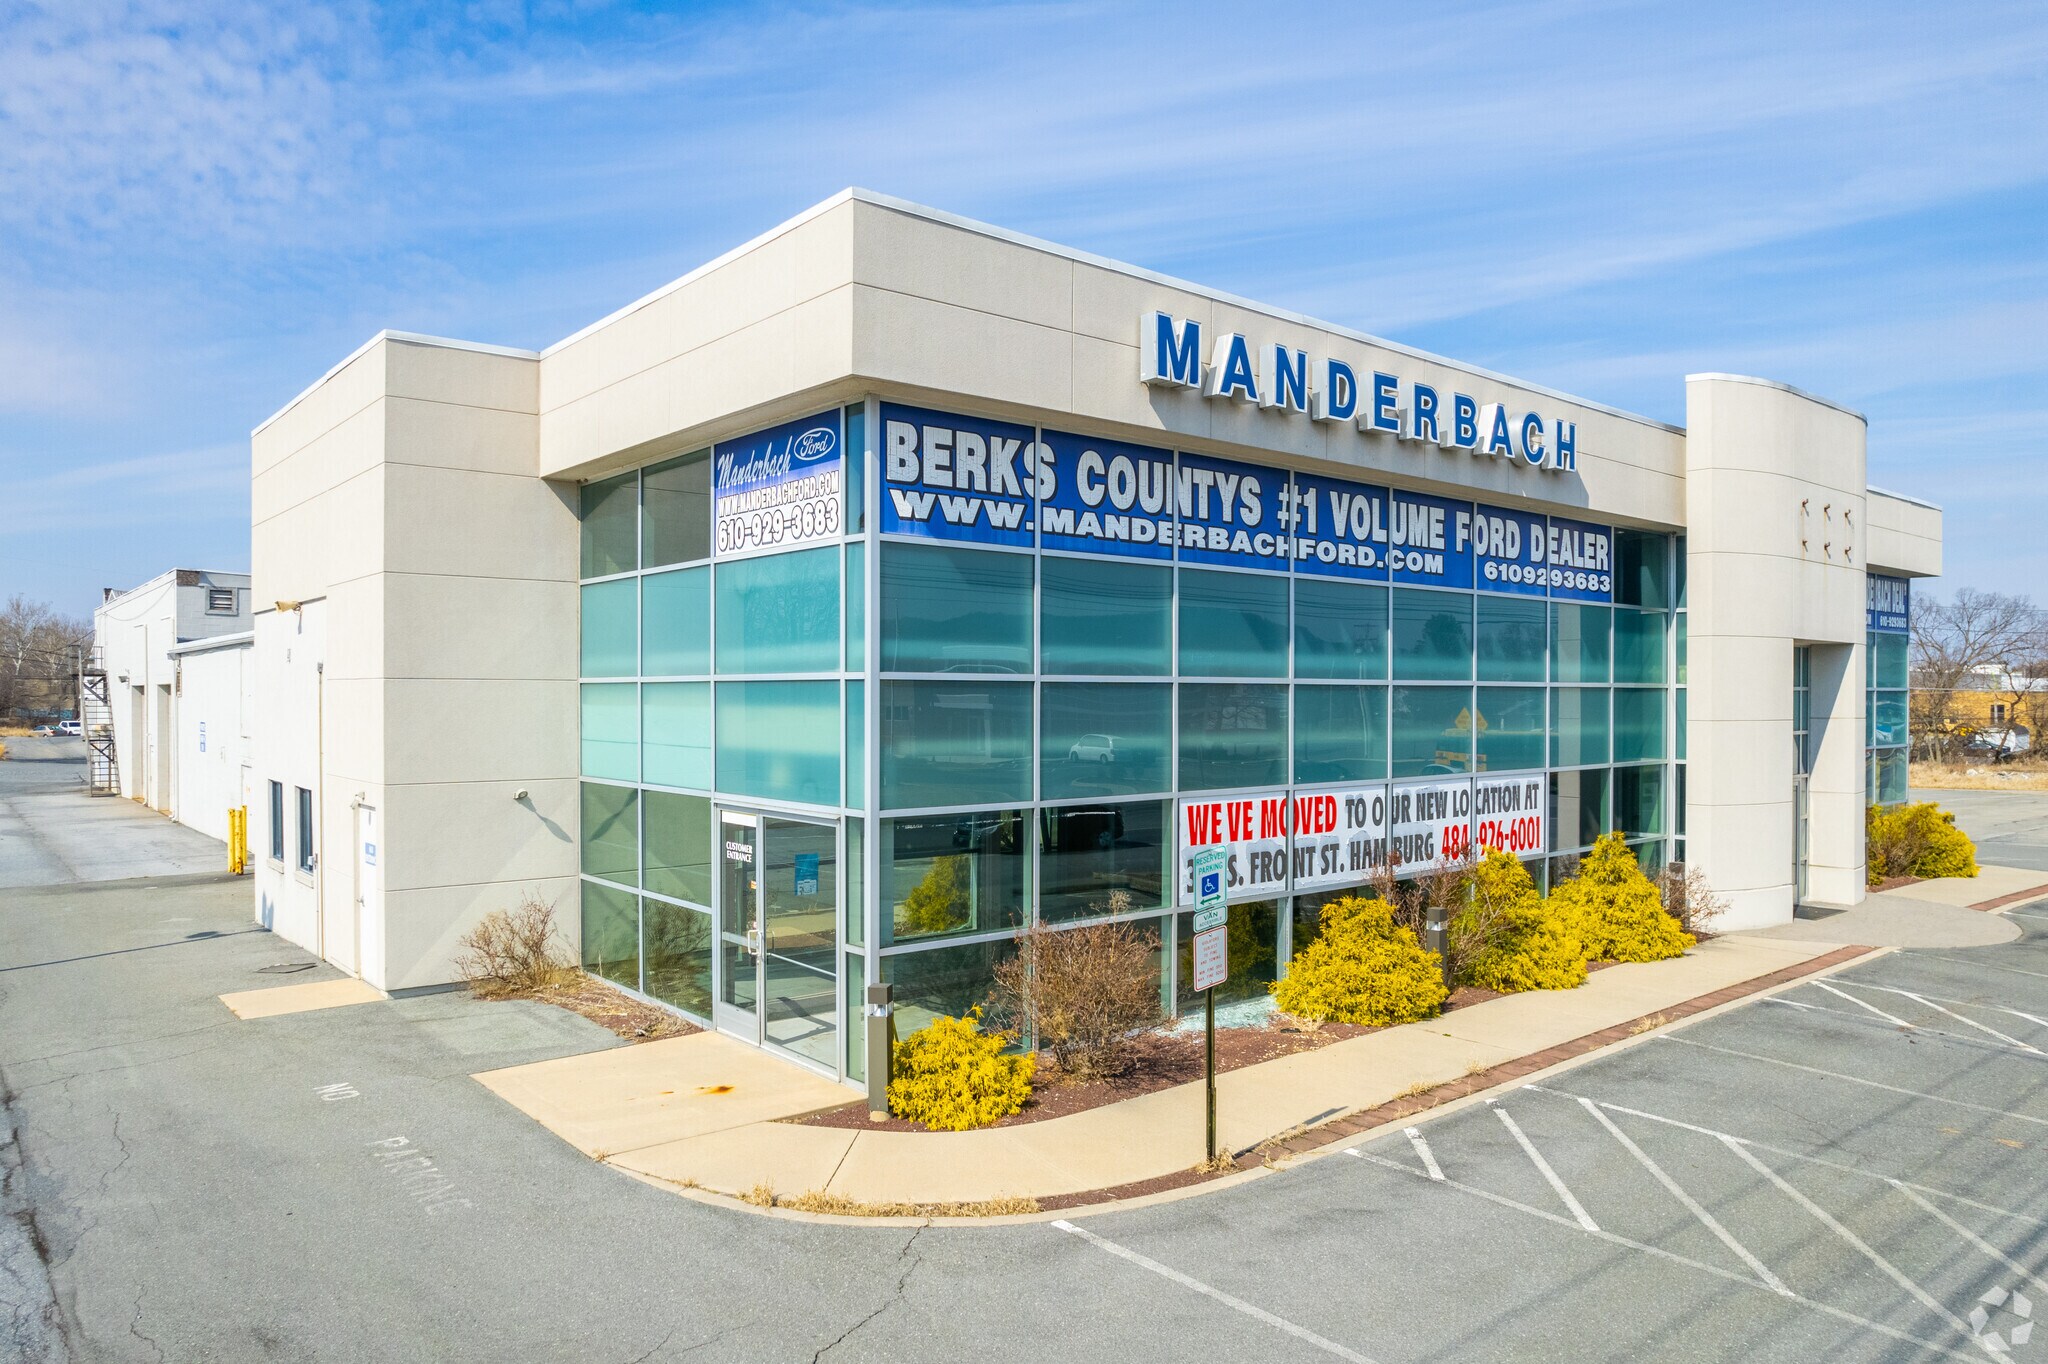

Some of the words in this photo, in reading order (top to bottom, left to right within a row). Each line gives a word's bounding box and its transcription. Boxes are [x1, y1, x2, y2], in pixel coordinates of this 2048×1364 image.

[1141, 311, 1577, 472] MANDERBACH
[717, 435, 793, 489] Manderbach
[800, 432, 829, 457] Ford
[886, 420, 1057, 500] BERKS
[1076, 450, 1262, 527] COUNTYS
[1277, 483, 1317, 534] #1
[1329, 491, 1445, 550] VOLUME
[1455, 510, 1521, 560] FORD
[1530, 523, 1609, 571] DEALER
[718, 498, 840, 552] 610-929-3683
[888, 489, 1444, 575] WWW.MANDERBACHFORD.COM
[1484, 561, 1611, 592] 6109293683
[1260, 795, 1337, 839] MOVED
[1345, 798, 1367, 829] TO
[1372, 795, 1411, 826] OUR
[1416, 791, 1448, 821] NEW
[1452, 784, 1520, 817] LOCATION
[1524, 783, 1539, 810] AT
[726, 841, 753, 854] CUSTOMER
[726, 850, 753, 863] ENTRANCE
[1196, 851, 1225, 866] RESERVED
[1198, 861, 1224, 876] PARKING
[1250, 845, 1316, 885] FRONT
[1321, 843, 1345, 876] ST.
[1350, 832, 1434, 872] HAMBURG
[1441, 816, 1541, 860] 484-926-6001
[1203, 911, 1219, 921] VAN
[312, 1082, 360, 1101] NO
